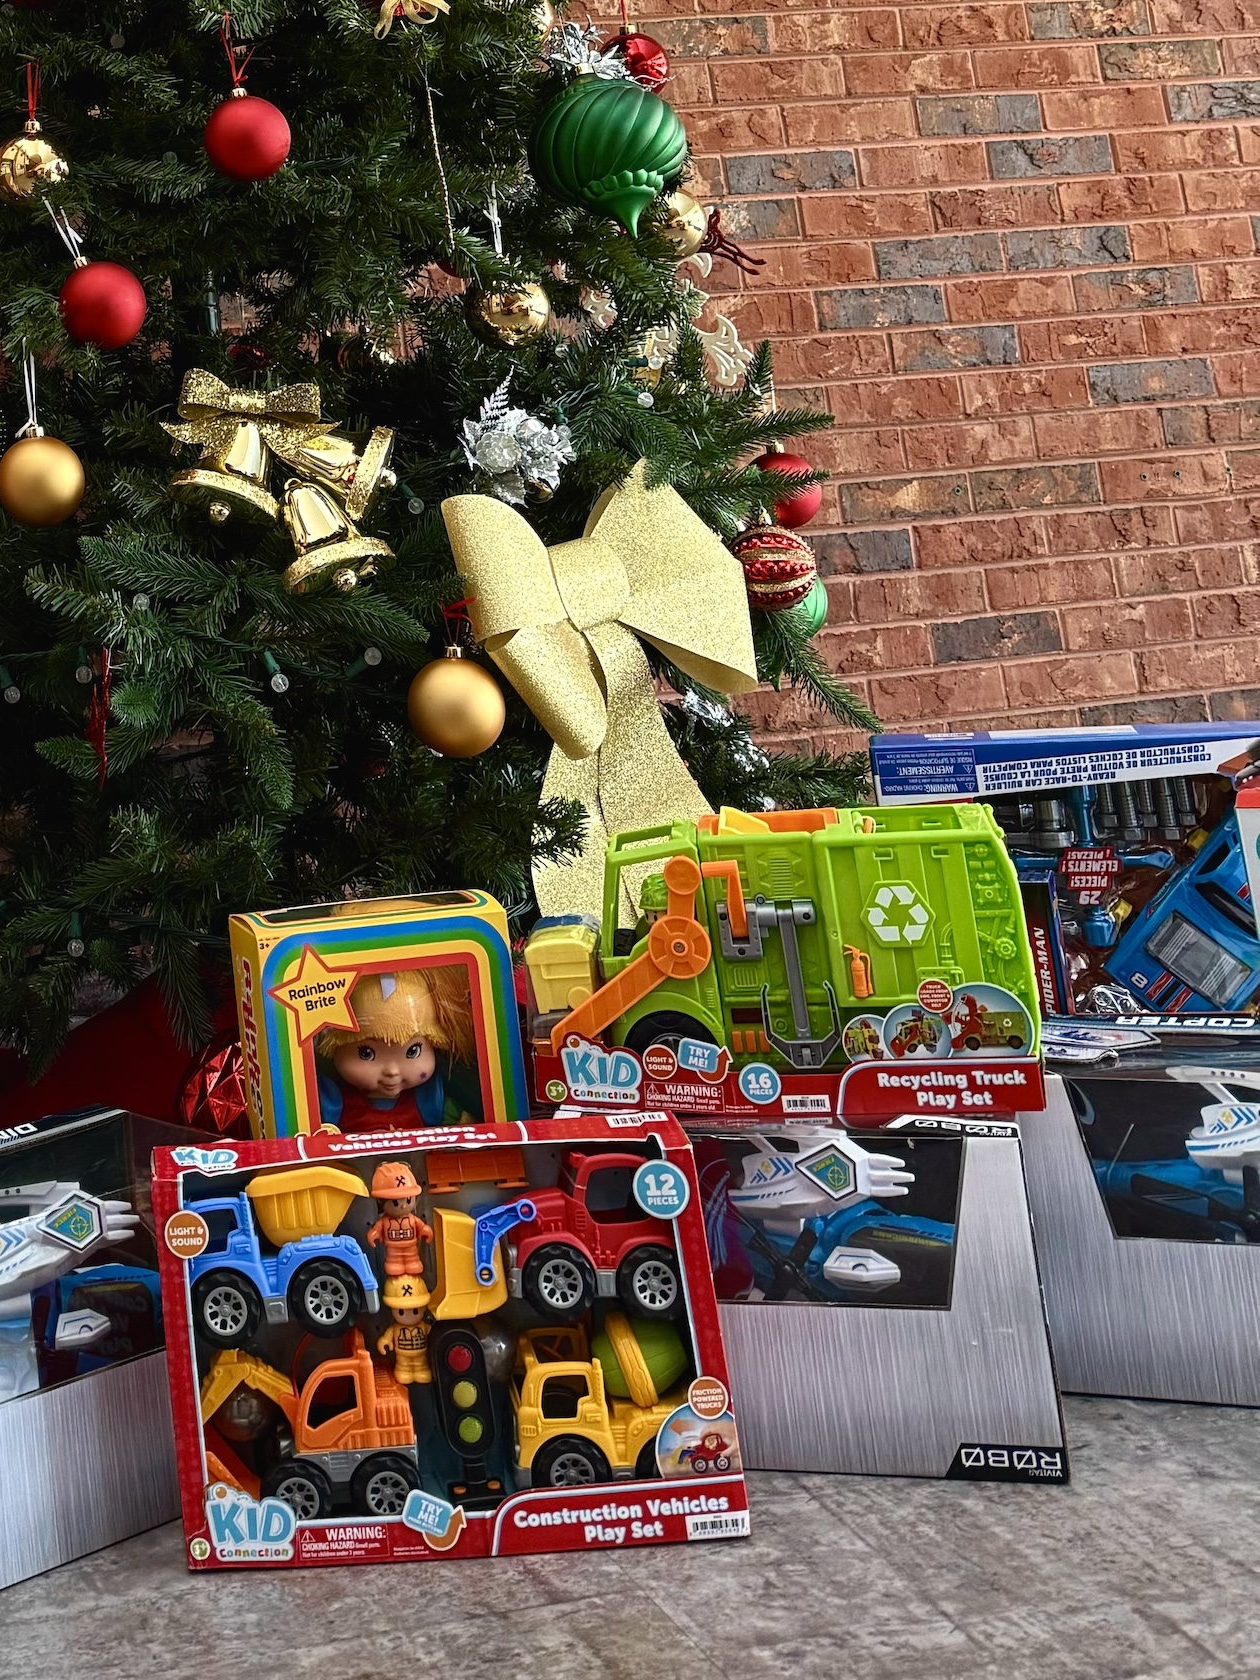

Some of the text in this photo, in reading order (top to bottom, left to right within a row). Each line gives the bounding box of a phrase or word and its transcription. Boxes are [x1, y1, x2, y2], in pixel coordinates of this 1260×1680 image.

[982, 744, 1206, 774] CONSTRUCTOR DE COCHES LISTOS PARA COMPETIR
[1125, 760, 1138, 769] DE
[1139, 752, 1212, 769] CONSTRUCTEUR
[896, 765, 954, 776] AVERTISSEMENT:
[1033, 767, 1057, 777] POUR
[1059, 764, 1088, 775] PRETE
[1089, 762, 1124, 773] VOITUR
[983, 771, 1020, 783] COURSE
[1021, 769, 1032, 779] LA
[1041, 771, 1116, 785] READY-TO-RACE
[923, 783, 959, 793] WARNING:
[985, 780, 1023, 791] BUILDER
[1025, 777, 1041, 787] CAR
[1067, 850, 1104, 859] PIEZAS!
[1070, 876, 1108, 887] PIECES!
[1079, 891, 1102, 905] 29
[259, 942, 270, 950] 3+
[1033, 927, 1057, 1016] PIDER-MAN
[1131, 972, 1148, 989] 8
[288, 978, 346, 1001] Rainbow
[305, 994, 337, 1012] Brite
[1114, 1016, 1255, 1028] COPTER
[689, 1045, 711, 1058] TRY
[646, 1056, 667, 1064] LIGHT
[688, 1055, 709, 1068] ME!
[565, 1051, 638, 1088] KID
[747, 1072, 771, 1089] 16
[877, 1070, 1028, 1090] Recycling Truck
[548, 1084, 564, 1097] 3+
[573, 1088, 636, 1100] Connection
[665, 1084, 722, 1098] WARNING:
[749, 1088, 774, 1096] PIECES
[646, 1092, 671, 1102] CHOKING
[917, 1090, 993, 1110] Play Set
[344, 1125, 476, 1142] Construction
[328, 1131, 498, 1152] Vehicles Play Set
[174, 1148, 238, 1166] KID
[644, 1173, 678, 1196] 12
[647, 1196, 679, 1206] PIECES
[169, 1227, 197, 1237] LIGHT
[171, 1236, 203, 1247] SOUND
[692, 1388, 723, 1397] FRICTION
[692, 1395, 724, 1404] POWERED
[696, 1401, 722, 1410] TRUCKS
[1028, 1468, 1063, 1478] VIVITAR
[420, 1499, 444, 1517] TRY
[513, 1494, 729, 1529] Construction Vehicles
[210, 1502, 291, 1545] KID
[418, 1510, 439, 1525] ME!
[325, 1526, 387, 1541] WARNING:
[584, 1520, 664, 1544] Play Set
[193, 1542, 208, 1554] 3+
[219, 1547, 290, 1558] Connection
[301, 1541, 330, 1552] CHOKING
